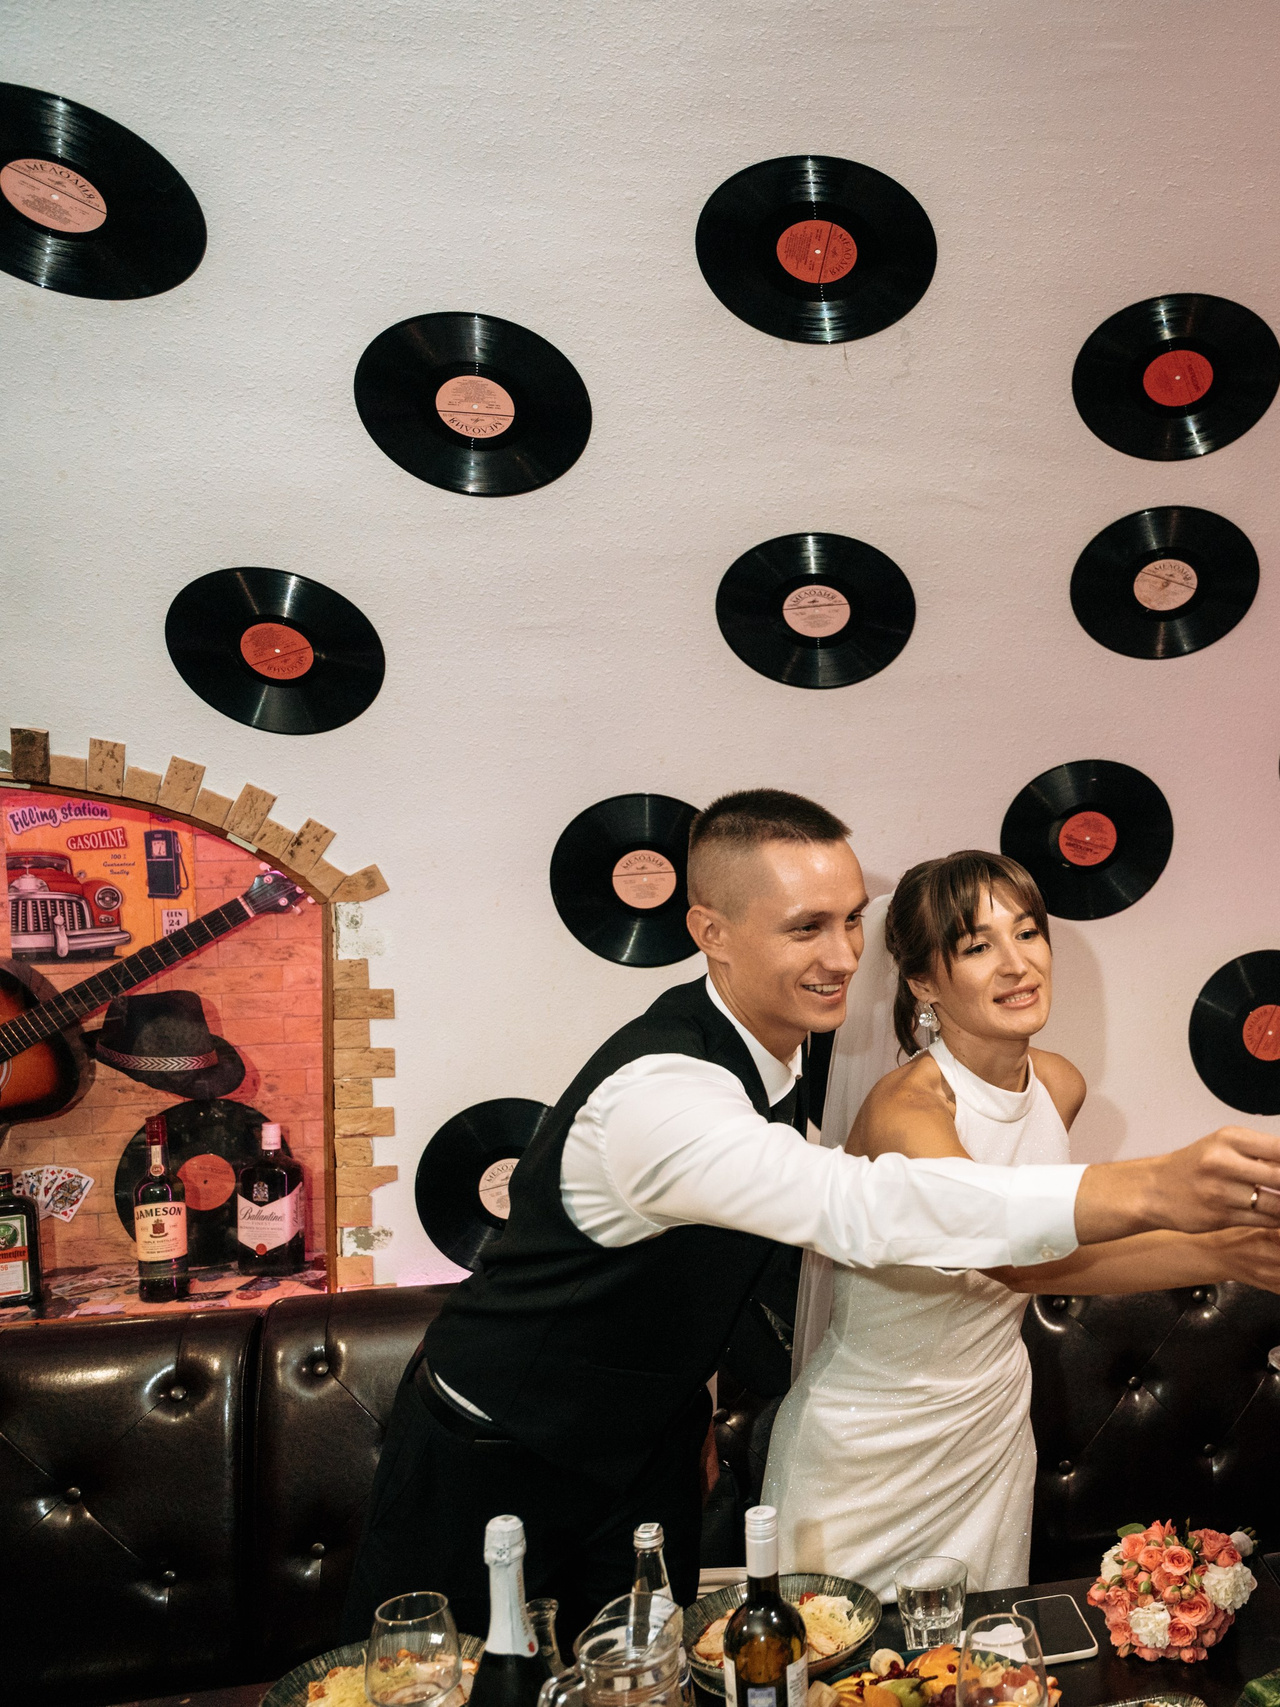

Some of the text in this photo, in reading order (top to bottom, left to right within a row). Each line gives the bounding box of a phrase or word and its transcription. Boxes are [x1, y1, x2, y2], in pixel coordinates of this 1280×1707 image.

[25, 163, 96, 200] МЕЛОДИЯ
[449, 417, 503, 435] МЕЛОДИЯ
[9, 802, 109, 833] Filling station
[67, 828, 126, 850] GASOLINE
[168, 919, 180, 927] 24
[486, 1164, 516, 1183] МЕЛОД
[135, 1207, 182, 1220] JAMESON
